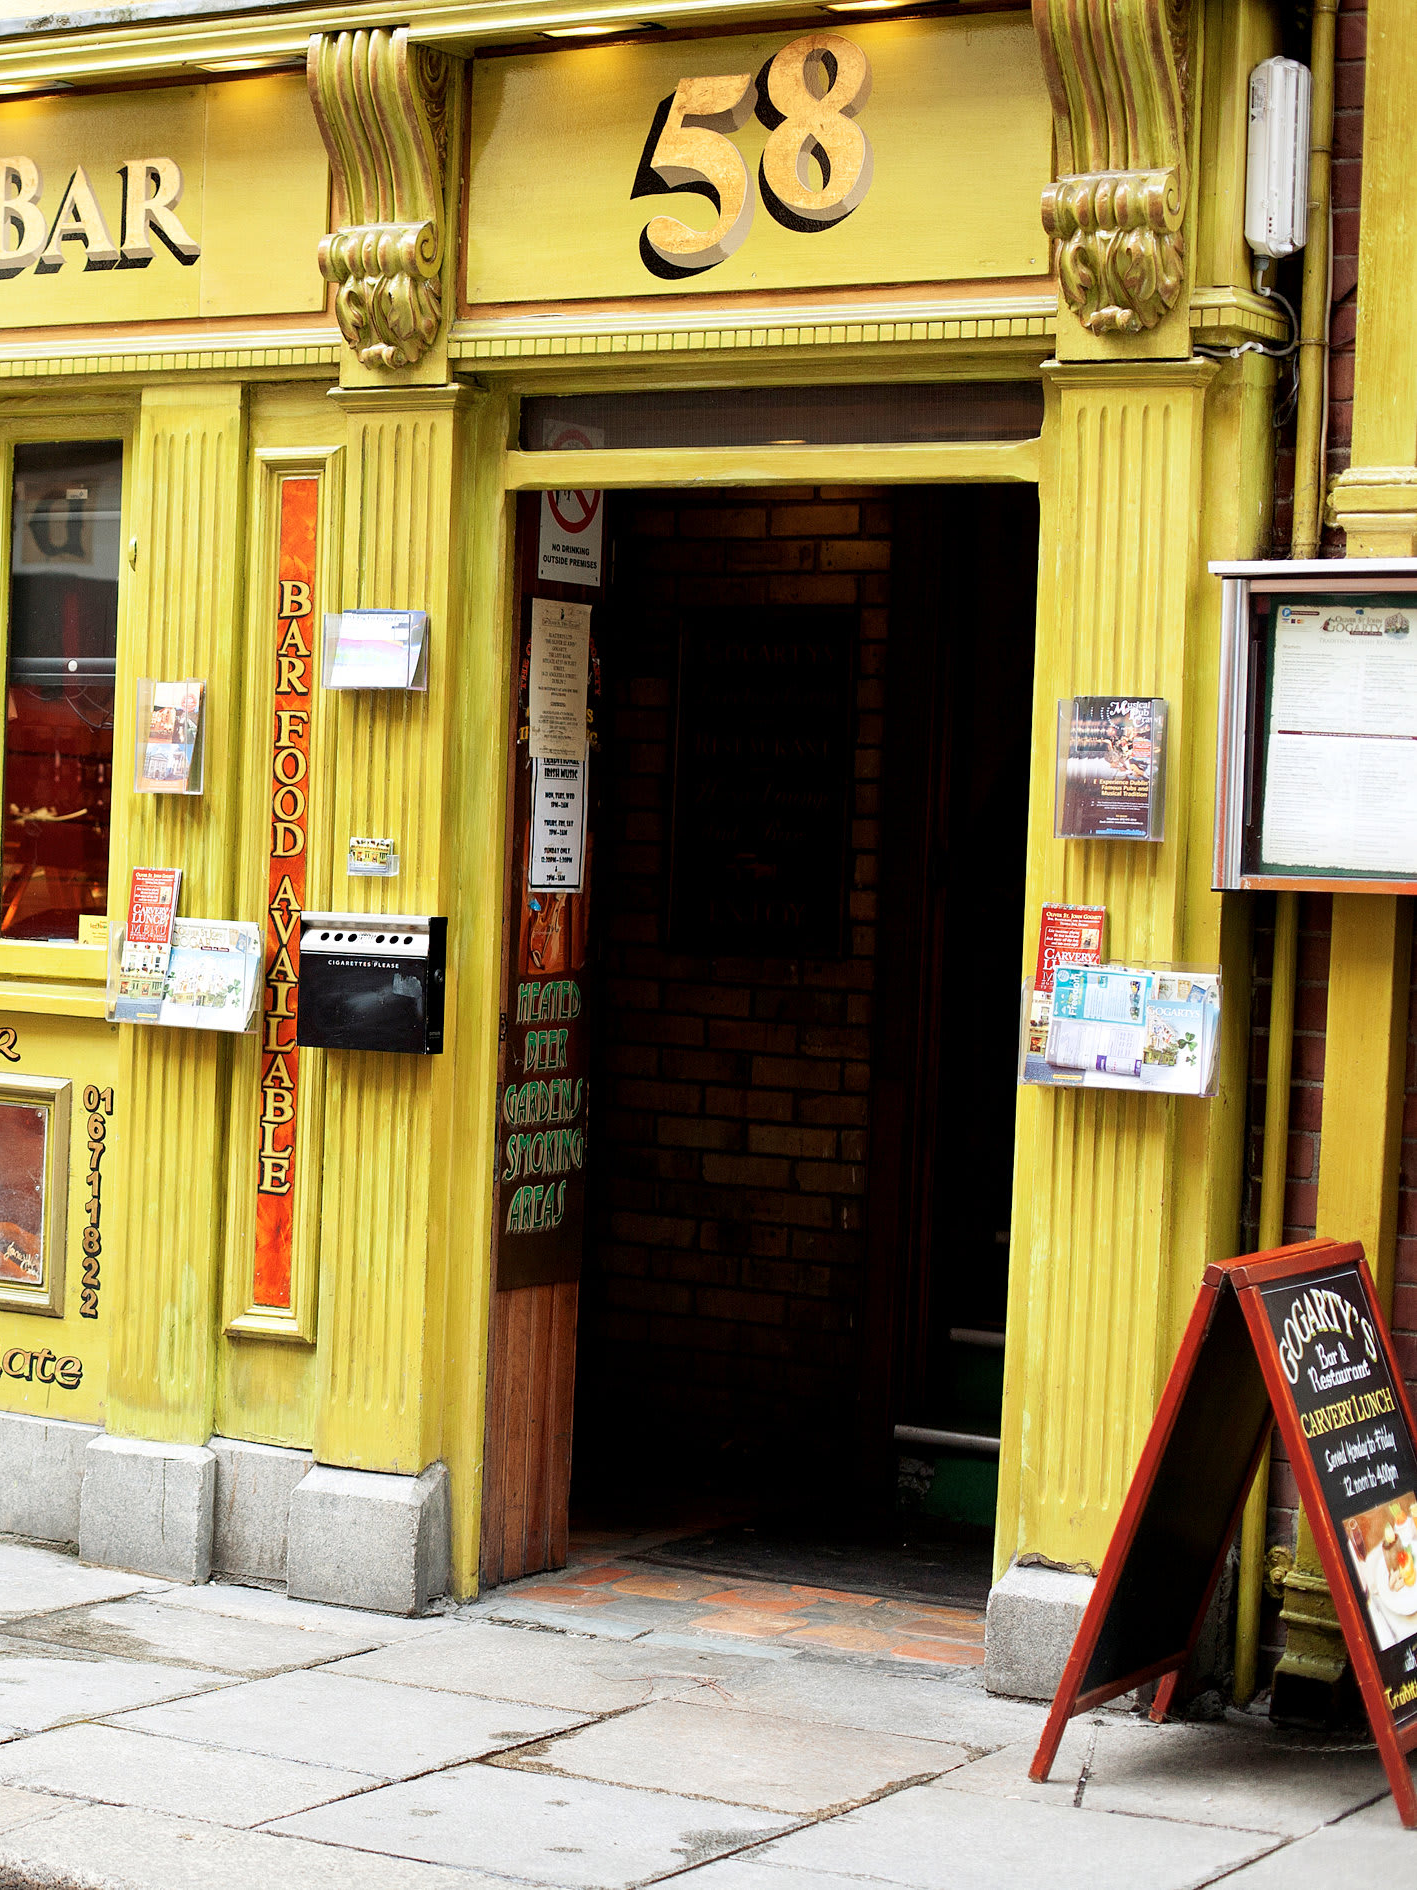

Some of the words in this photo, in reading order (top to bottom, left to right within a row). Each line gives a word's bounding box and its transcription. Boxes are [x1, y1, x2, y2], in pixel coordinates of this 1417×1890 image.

[630, 33, 874, 280] 58
[543, 555, 568, 566] OUTSIDE
[569, 557, 597, 569] PREMISES
[552, 543, 561, 552] NO
[562, 544, 590, 556] DRINKING
[275, 579, 312, 696] BAR
[1326, 621, 1383, 633] GOGARTY
[1110, 700, 1151, 715] Musical
[1129, 708, 1149, 721] Pub
[271, 710, 309, 858] FOOD
[544, 767, 560, 778] IRISH
[560, 768, 578, 779] MUSIC
[328, 959, 372, 969] CIGARETTES
[373, 961, 400, 970] PLEASE
[1044, 948, 1096, 962] CARVERY
[516, 980, 581, 1025] HEATED
[1145, 1004, 1201, 1017] GOGARTYS
[257, 874, 301, 1196] AVAILABLE
[523, 1028, 569, 1073] BEER
[503, 1078, 583, 1127] GARDENS
[502, 1126, 583, 1184] SMOKING
[505, 1179, 567, 1235] AREAS
[1279, 1288, 1377, 1384] GOGARTY'S
[1315, 1342, 1338, 1370] Bar
[1338, 1341, 1349, 1364] &
[1307, 1358, 1371, 1393] Restaurant
[1300, 1400, 1358, 1439] CARVERY
[1351, 1387, 1396, 1421] LUNCH
[1343, 1474, 1356, 1498] 12
